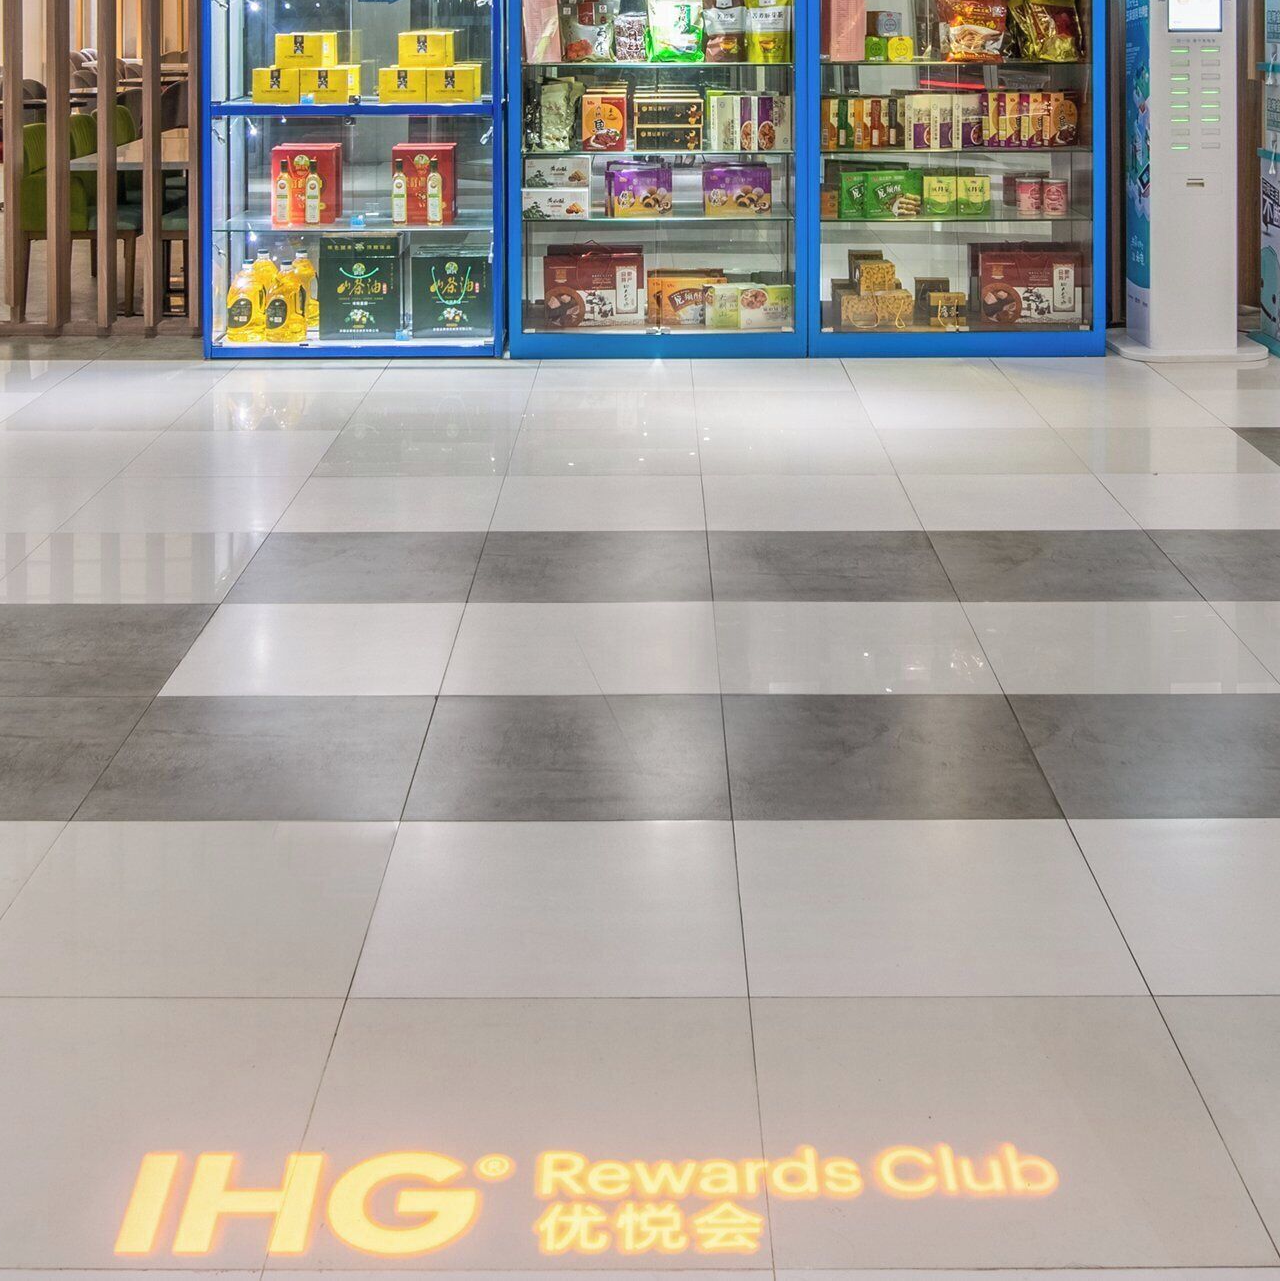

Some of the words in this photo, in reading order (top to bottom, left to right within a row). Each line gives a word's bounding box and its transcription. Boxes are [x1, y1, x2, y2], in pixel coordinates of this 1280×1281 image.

[337, 278, 382, 296] 山茶油
[539, 1144, 861, 1197] Rewards
[876, 1142, 1058, 1197] Club
[112, 1151, 482, 1256] IHG
[538, 1202, 764, 1253] 优悦会
